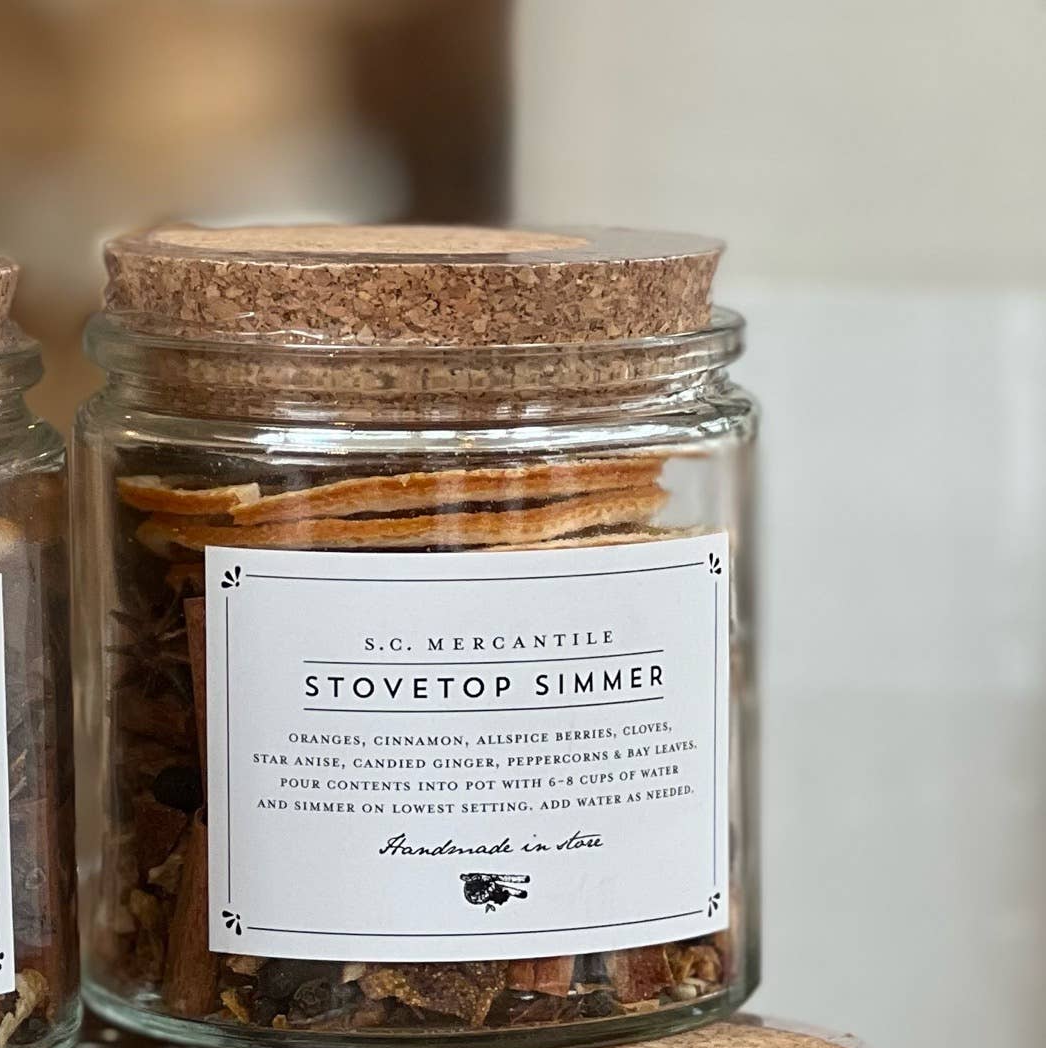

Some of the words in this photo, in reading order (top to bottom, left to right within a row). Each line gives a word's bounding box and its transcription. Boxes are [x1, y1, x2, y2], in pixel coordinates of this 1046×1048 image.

[364, 637, 412, 652] S.C.
[427, 630, 614, 652] MERCANTILE
[304, 675, 511, 700] STOVETOP
[535, 664, 663, 697] SIMMER
[288, 732, 366, 749] ORANGES,
[373, 735, 470, 749] CINNAMON,
[475, 732, 549, 746] ALLSPICE
[555, 727, 618, 742] BERRIES,
[622, 721, 673, 737] CLOVES,
[253, 753, 289, 766] STAR
[293, 755, 346, 770] ANISE,
[352, 757, 427, 769] CANDIED
[432, 757, 500, 770] GINGER,
[507, 750, 609, 767] PEPPERCORNS
[613, 749, 622, 760] &
[626, 745, 651, 759] BAY
[654, 739, 698, 755] LEAVES.
[280, 777, 321, 790] POUR
[326, 779, 411, 793] CONTENTS
[417, 780, 459, 792] INTO
[465, 779, 497, 791] POT
[501, 777, 543, 790] WITH
[579, 771, 615, 786] CUPS
[618, 770, 637, 782] OF
[640, 764, 679, 779] WATER
[257, 798, 288, 810] AND
[293, 800, 356, 813] SIMMER
[361, 802, 385, 814] ON
[392, 803, 456, 815] LOWEST
[461, 800, 534, 814] SETTING.
[539, 798, 571, 811] ADD
[575, 794, 622, 808] WATER
[626, 791, 642, 803] AS
[378, 832, 515, 857] Handmade
[519, 833, 552, 853] in
[555, 829, 604, 851] store
